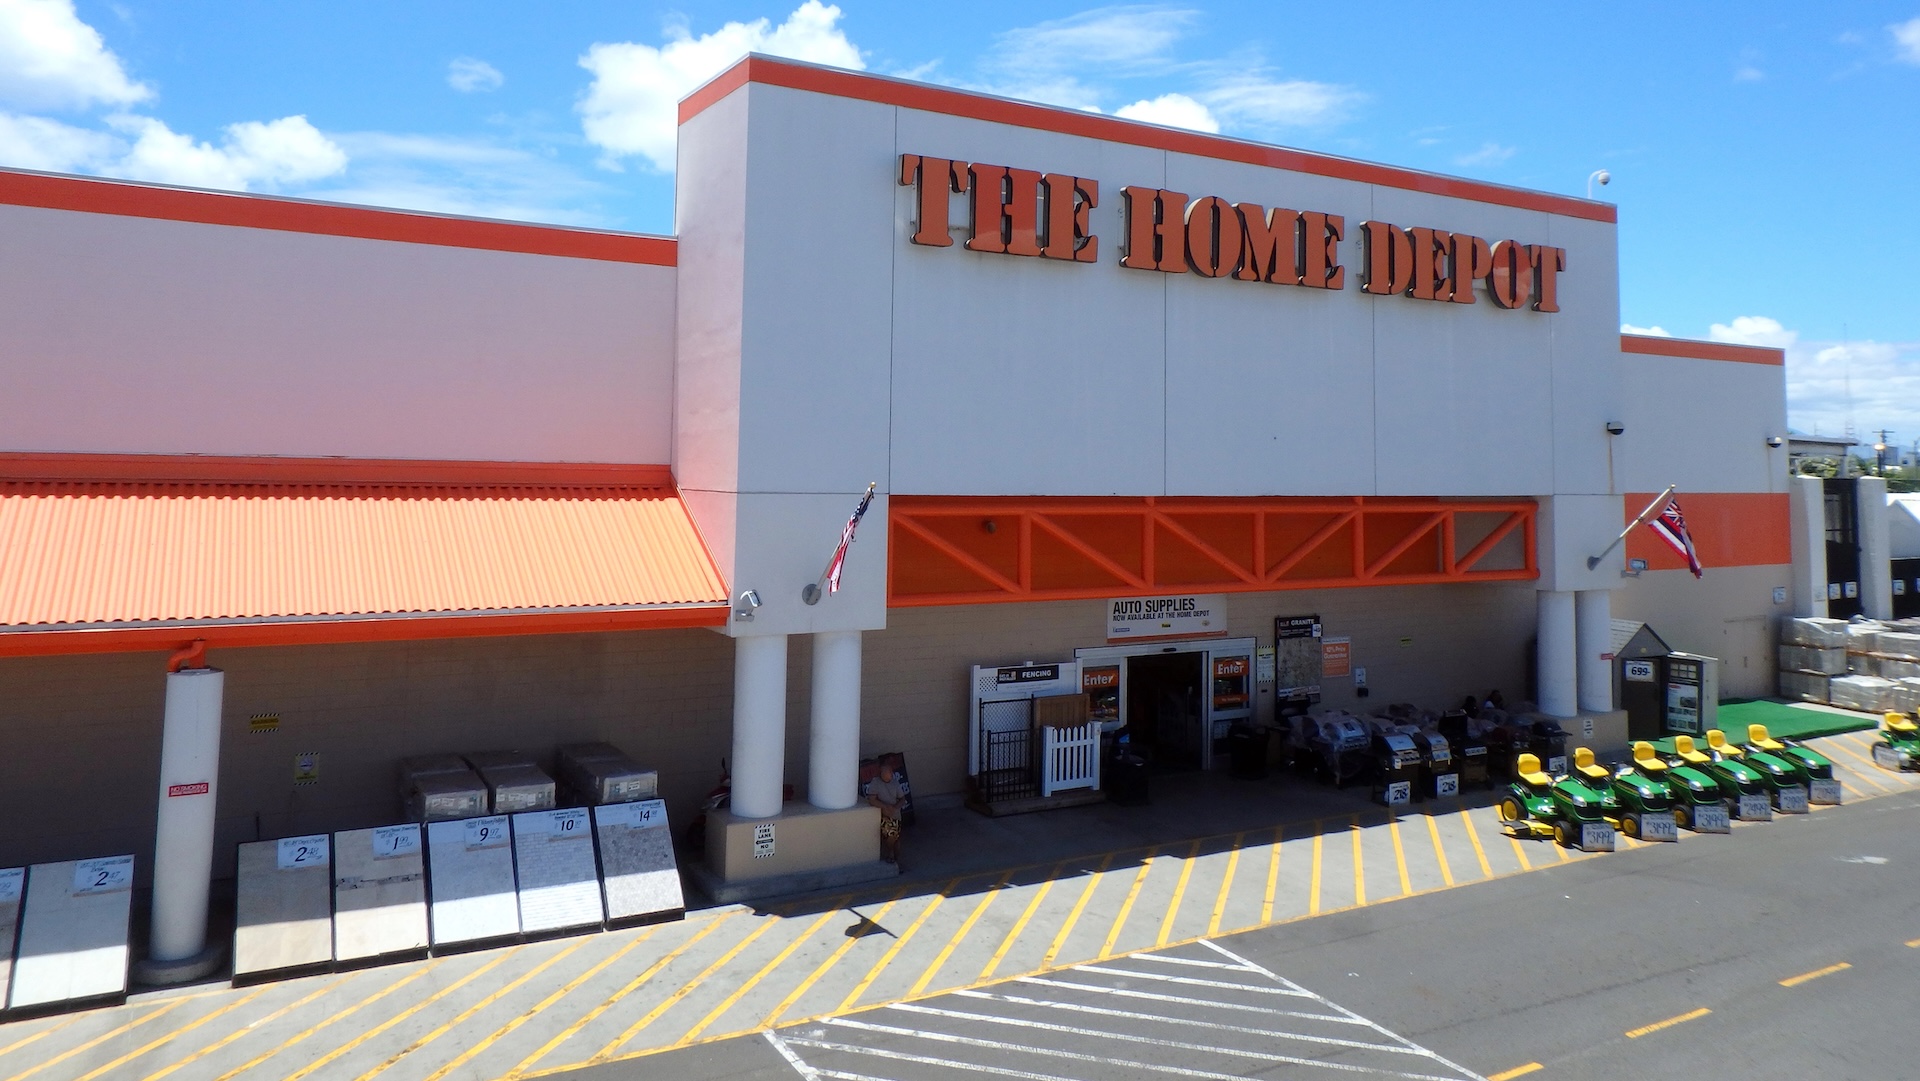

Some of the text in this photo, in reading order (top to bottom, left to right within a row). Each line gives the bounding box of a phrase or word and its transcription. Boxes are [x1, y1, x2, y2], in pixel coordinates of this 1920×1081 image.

[900, 153, 1566, 313] THE HOME DEPOT
[1113, 598, 1195, 614] AUTO SUPPLIES
[1291, 618, 1314, 626] GRANITE
[1022, 669, 1051, 679] FENCING
[1218, 664, 1244, 674] Enter
[1084, 674, 1114, 686] Enter
